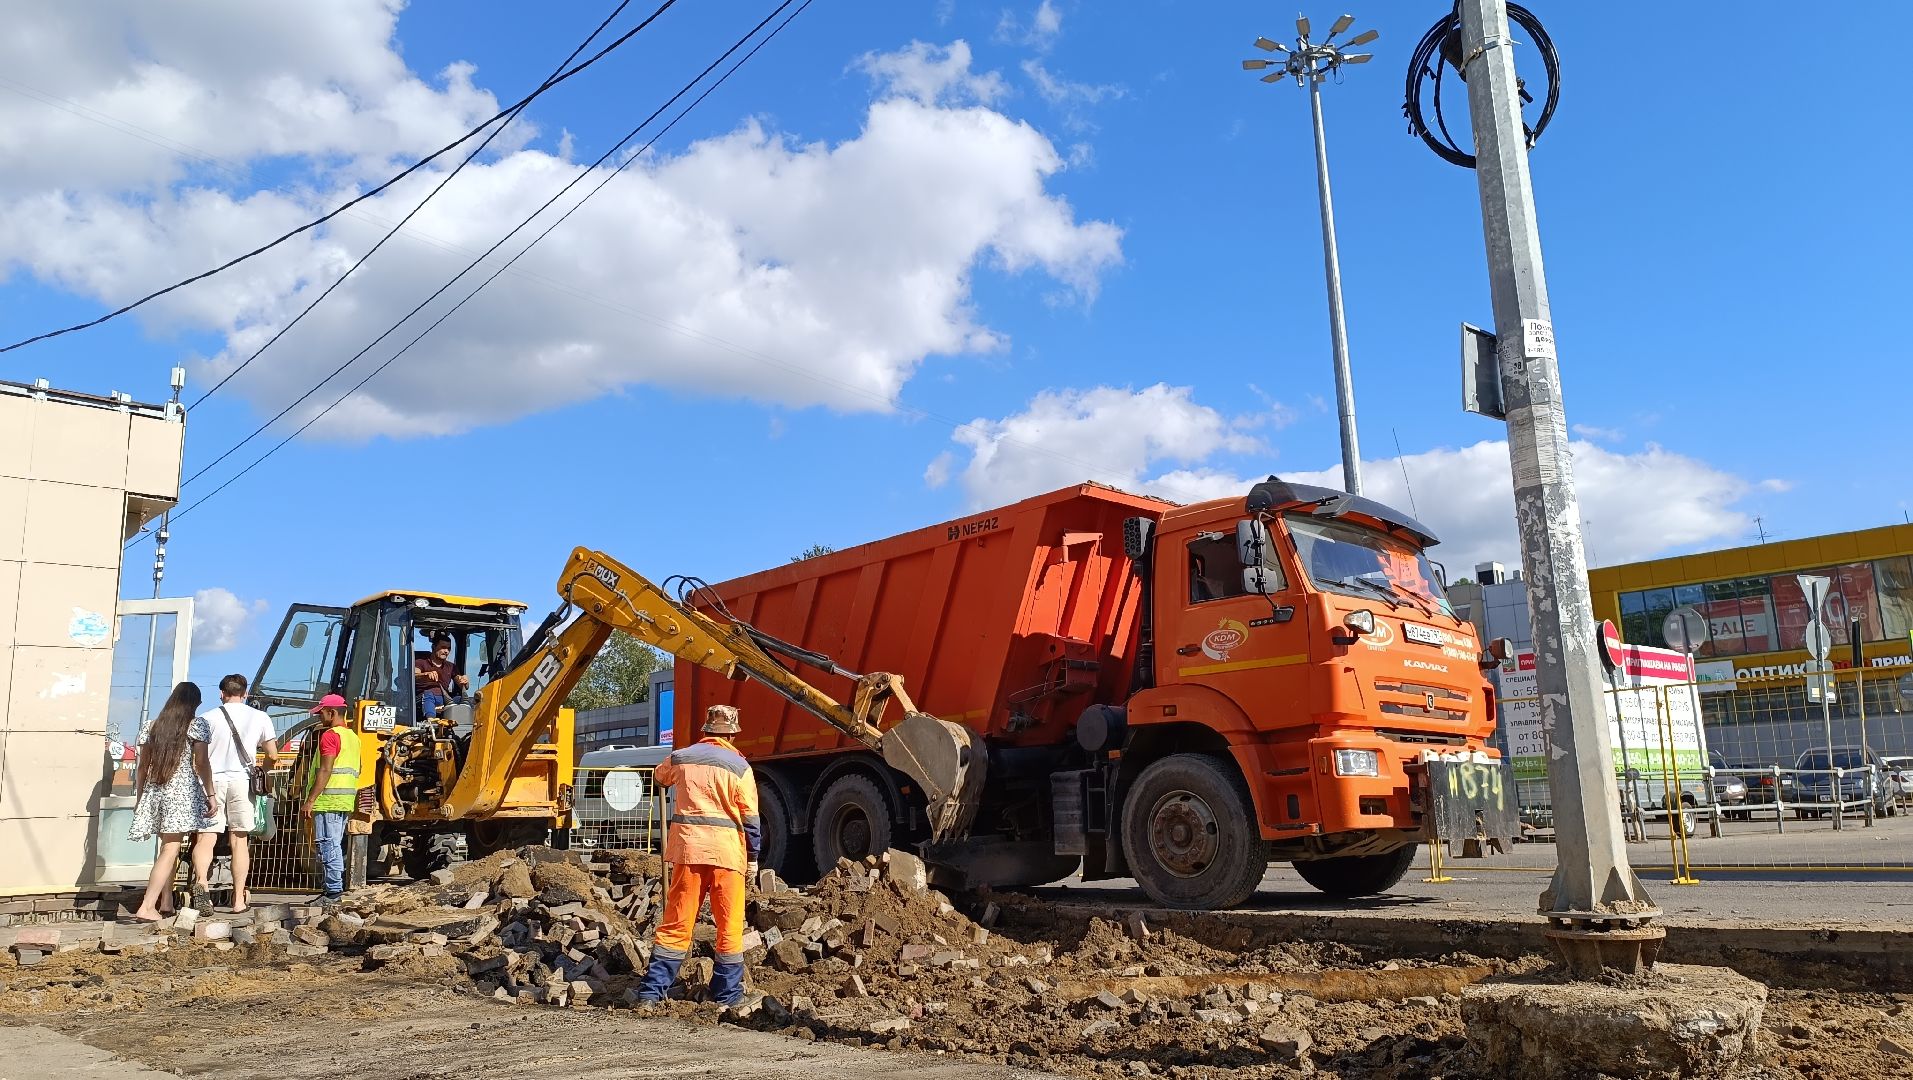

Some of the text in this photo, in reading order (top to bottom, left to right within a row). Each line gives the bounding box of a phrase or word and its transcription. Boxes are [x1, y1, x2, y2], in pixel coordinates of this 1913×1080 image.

[962, 516, 999, 537] NEFAZ
[1710, 619, 1756, 636] SALE
[1213, 633, 1236, 642] KDM
[1403, 659, 1449, 673] KAMAZ
[1672, 662, 1688, 673] РАБОТ
[1736, 663, 1807, 682] ОПТИК
[1505, 674, 1537, 683] СПЕЦИАЛ
[505, 654, 561, 730] JCB
[1526, 686, 1539, 696] 55
[1528, 699, 1541, 708] 65
[368, 706, 392, 717] 5493
[1531, 730, 1544, 740] 80
[1531, 743, 1544, 753] 11
